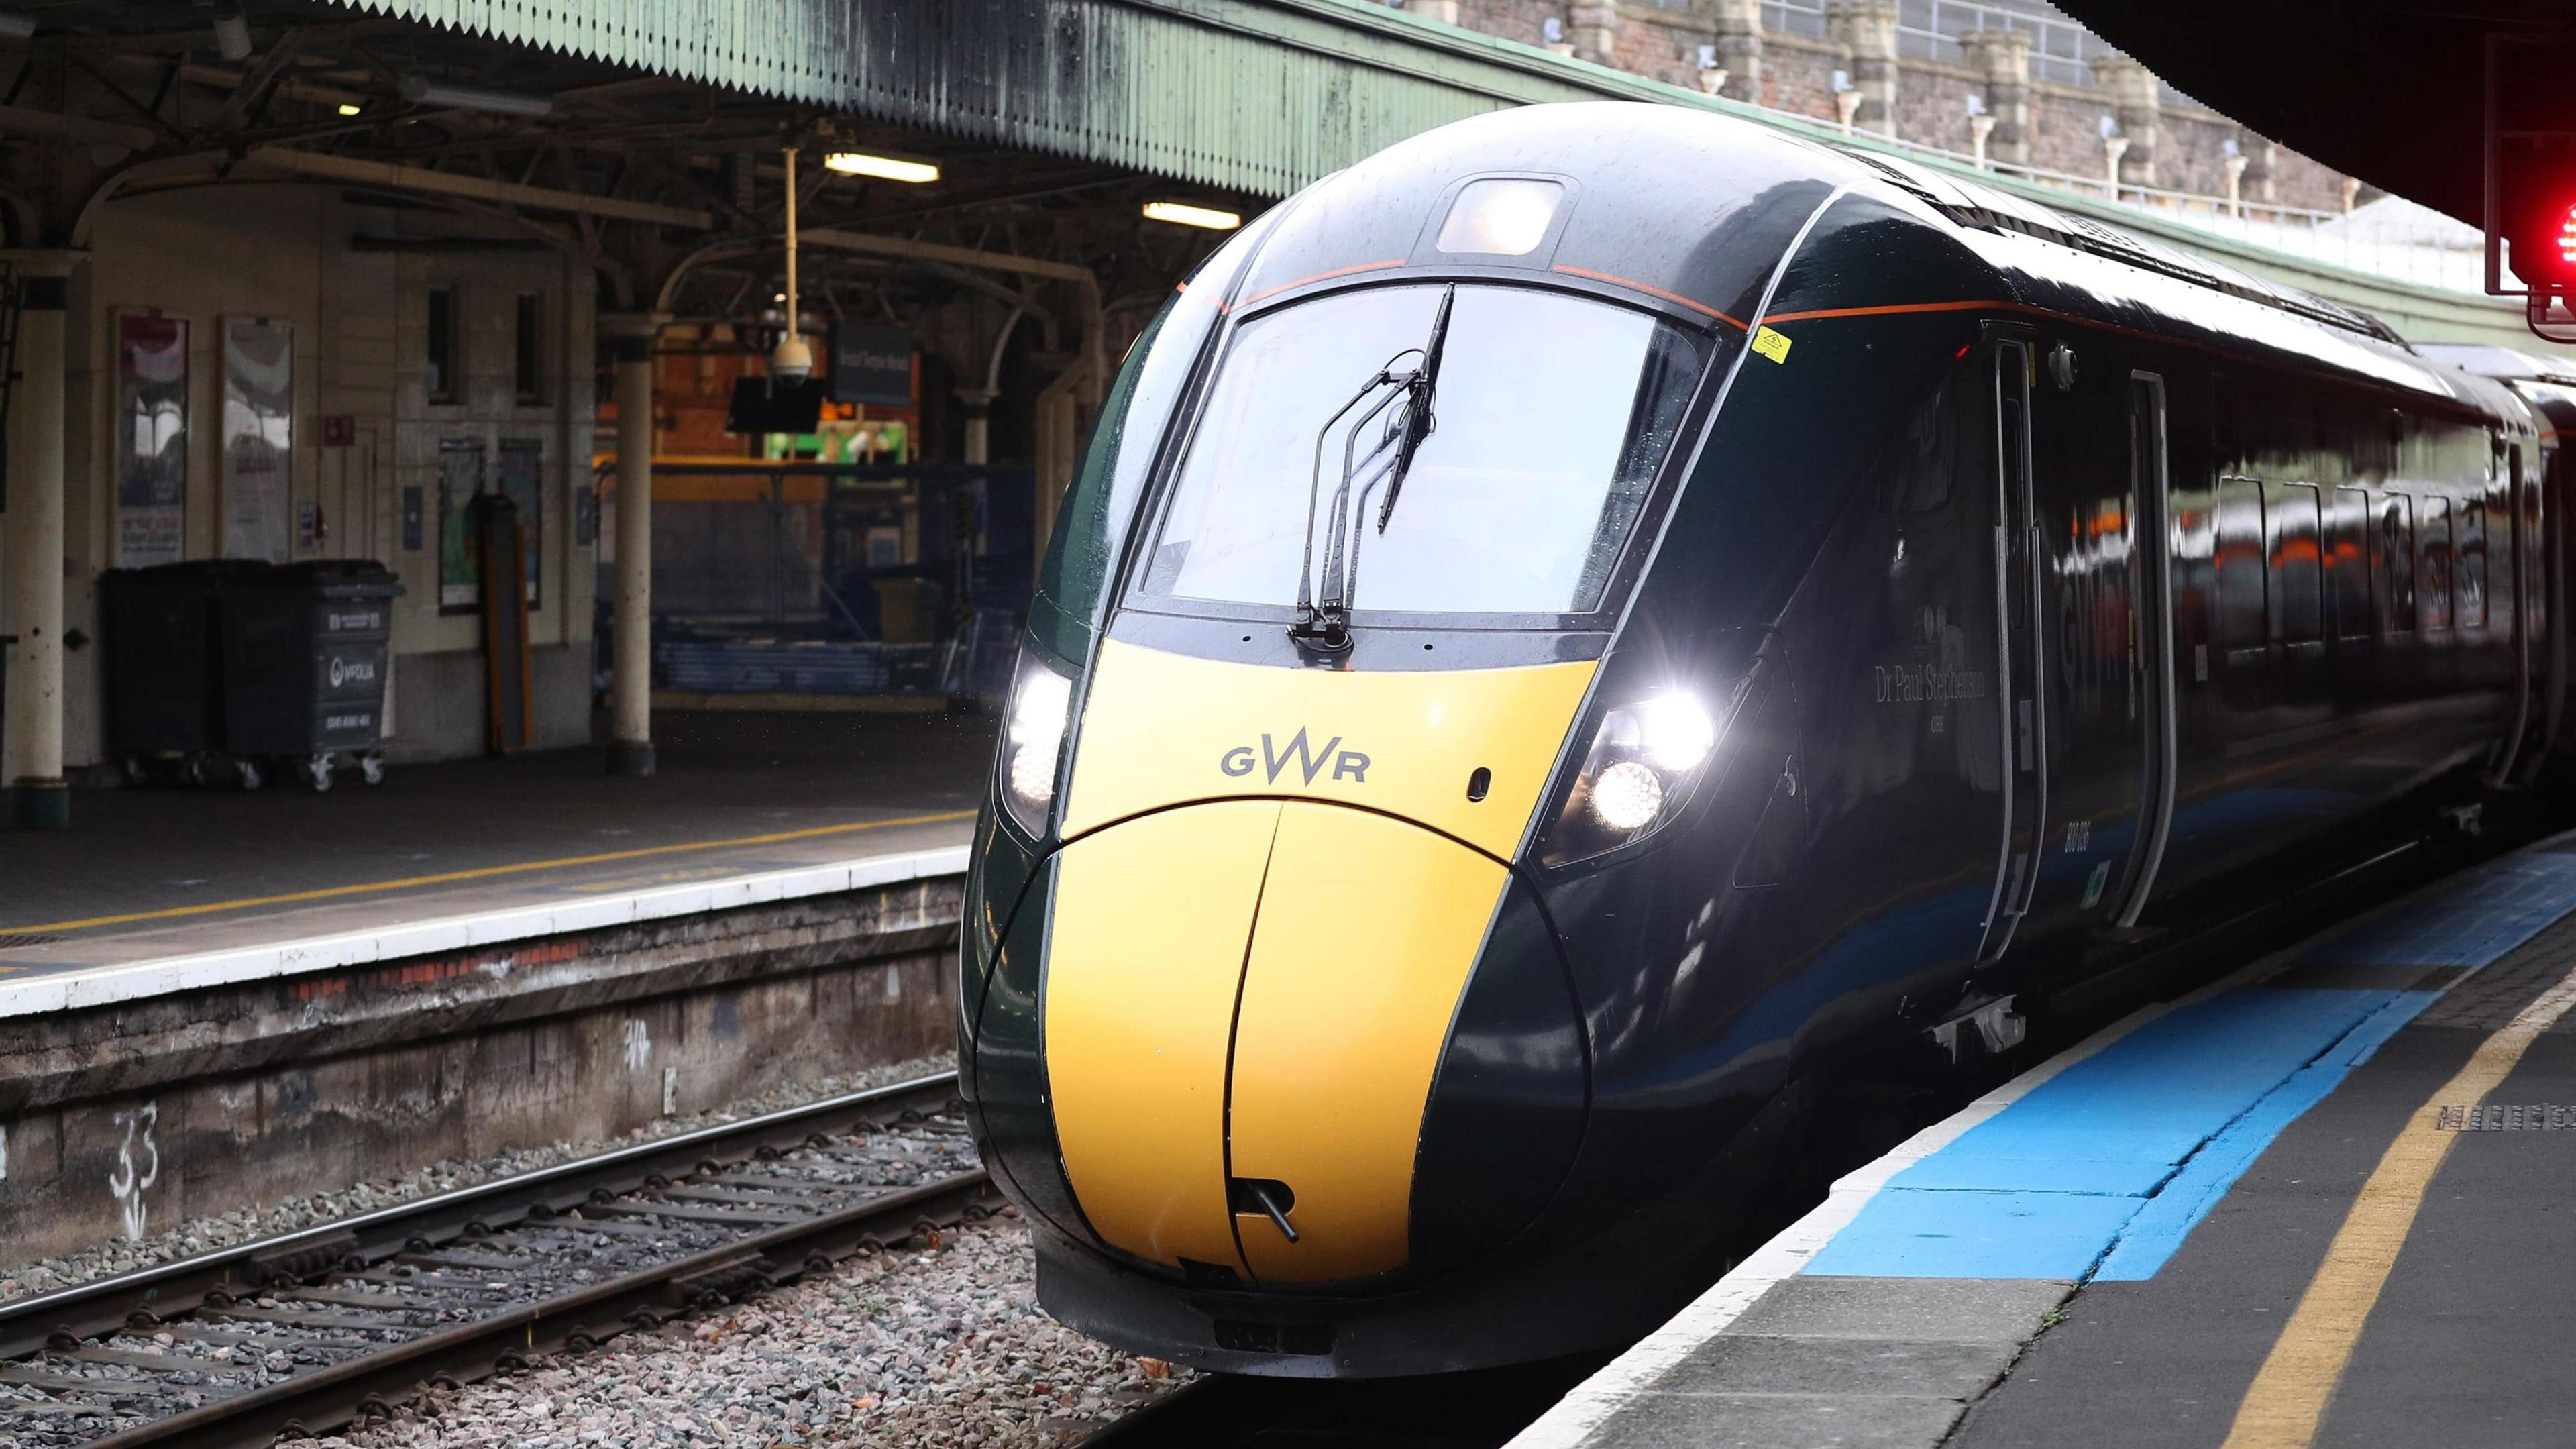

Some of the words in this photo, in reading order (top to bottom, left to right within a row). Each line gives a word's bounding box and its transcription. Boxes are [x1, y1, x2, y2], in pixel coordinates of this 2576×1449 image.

[1875, 665, 1892, 702] Dr
[1894, 664, 1923, 702] Paul
[1926, 664, 1985, 708] Stephenson
[1220, 725, 1371, 787] GWR
